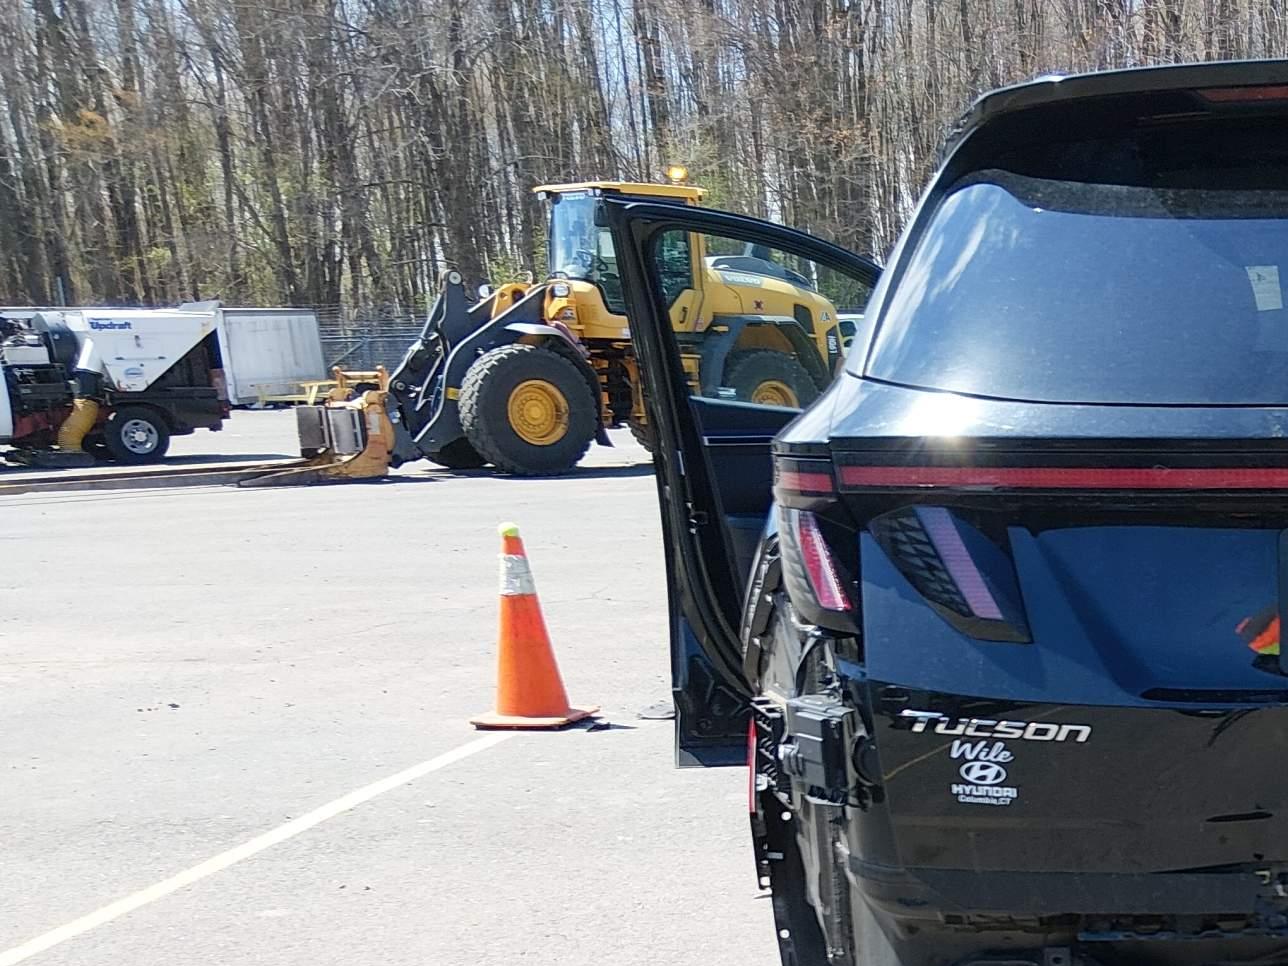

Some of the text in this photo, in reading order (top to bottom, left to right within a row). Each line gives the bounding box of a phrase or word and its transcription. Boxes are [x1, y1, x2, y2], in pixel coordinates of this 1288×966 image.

[89, 321, 132, 331] Updraft
[898, 709, 1092, 743] Tucson
[949, 740, 1015, 763] Wile
[951, 784, 1018, 798] HYUNDAI
